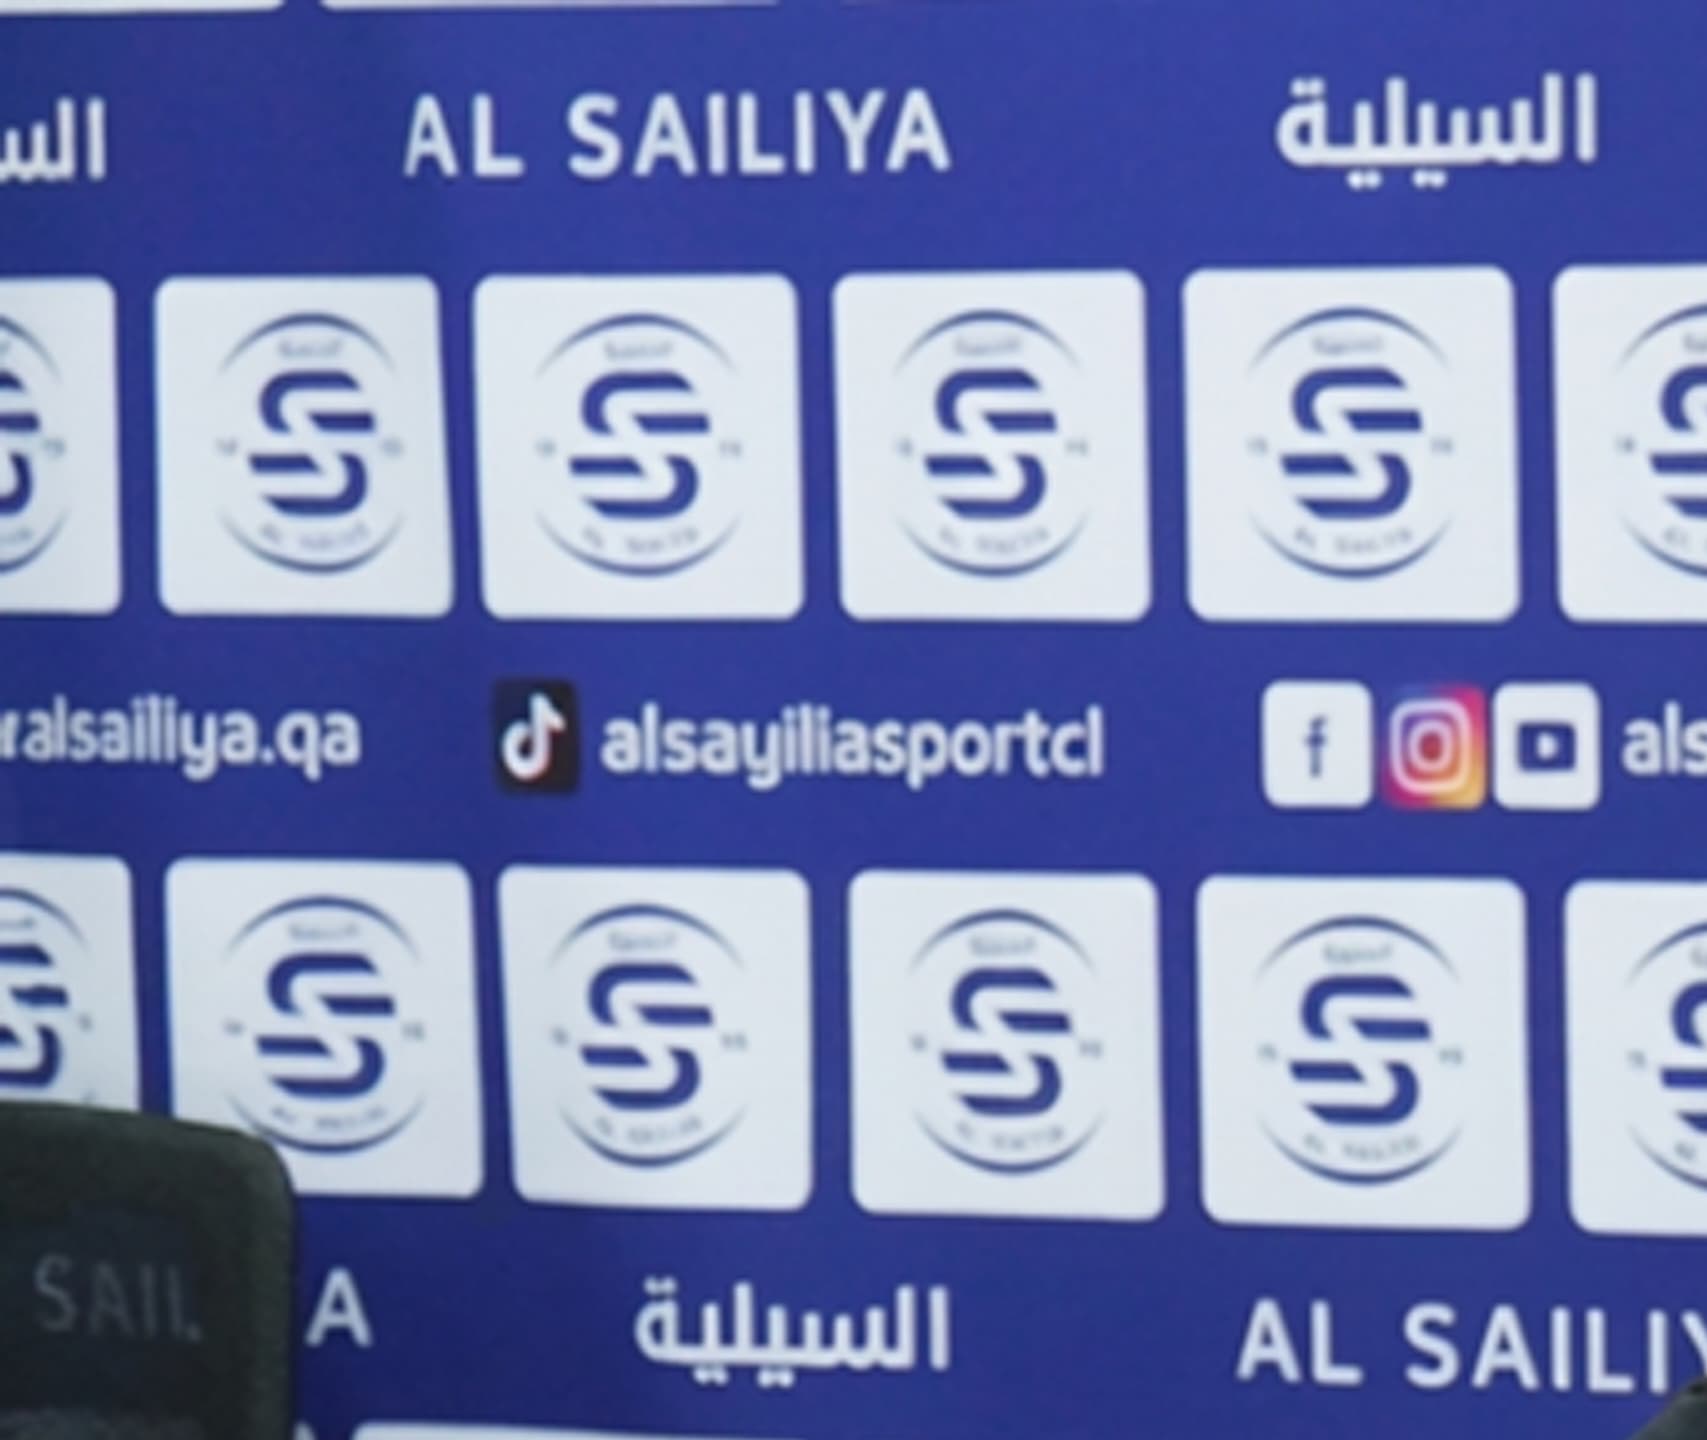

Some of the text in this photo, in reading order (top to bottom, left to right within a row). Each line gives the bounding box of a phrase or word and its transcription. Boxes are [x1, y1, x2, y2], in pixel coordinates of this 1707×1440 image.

[404, 88, 951, 178] AL SAILIYA
[1275, 73, 1597, 190] السيلية
[0, 693, 363, 783] alsailiya.qa
[600, 702, 1105, 791] alsayiliasportcl
[635, 1277, 949, 1388] السيلية
[1237, 1298, 1364, 1385] AL
